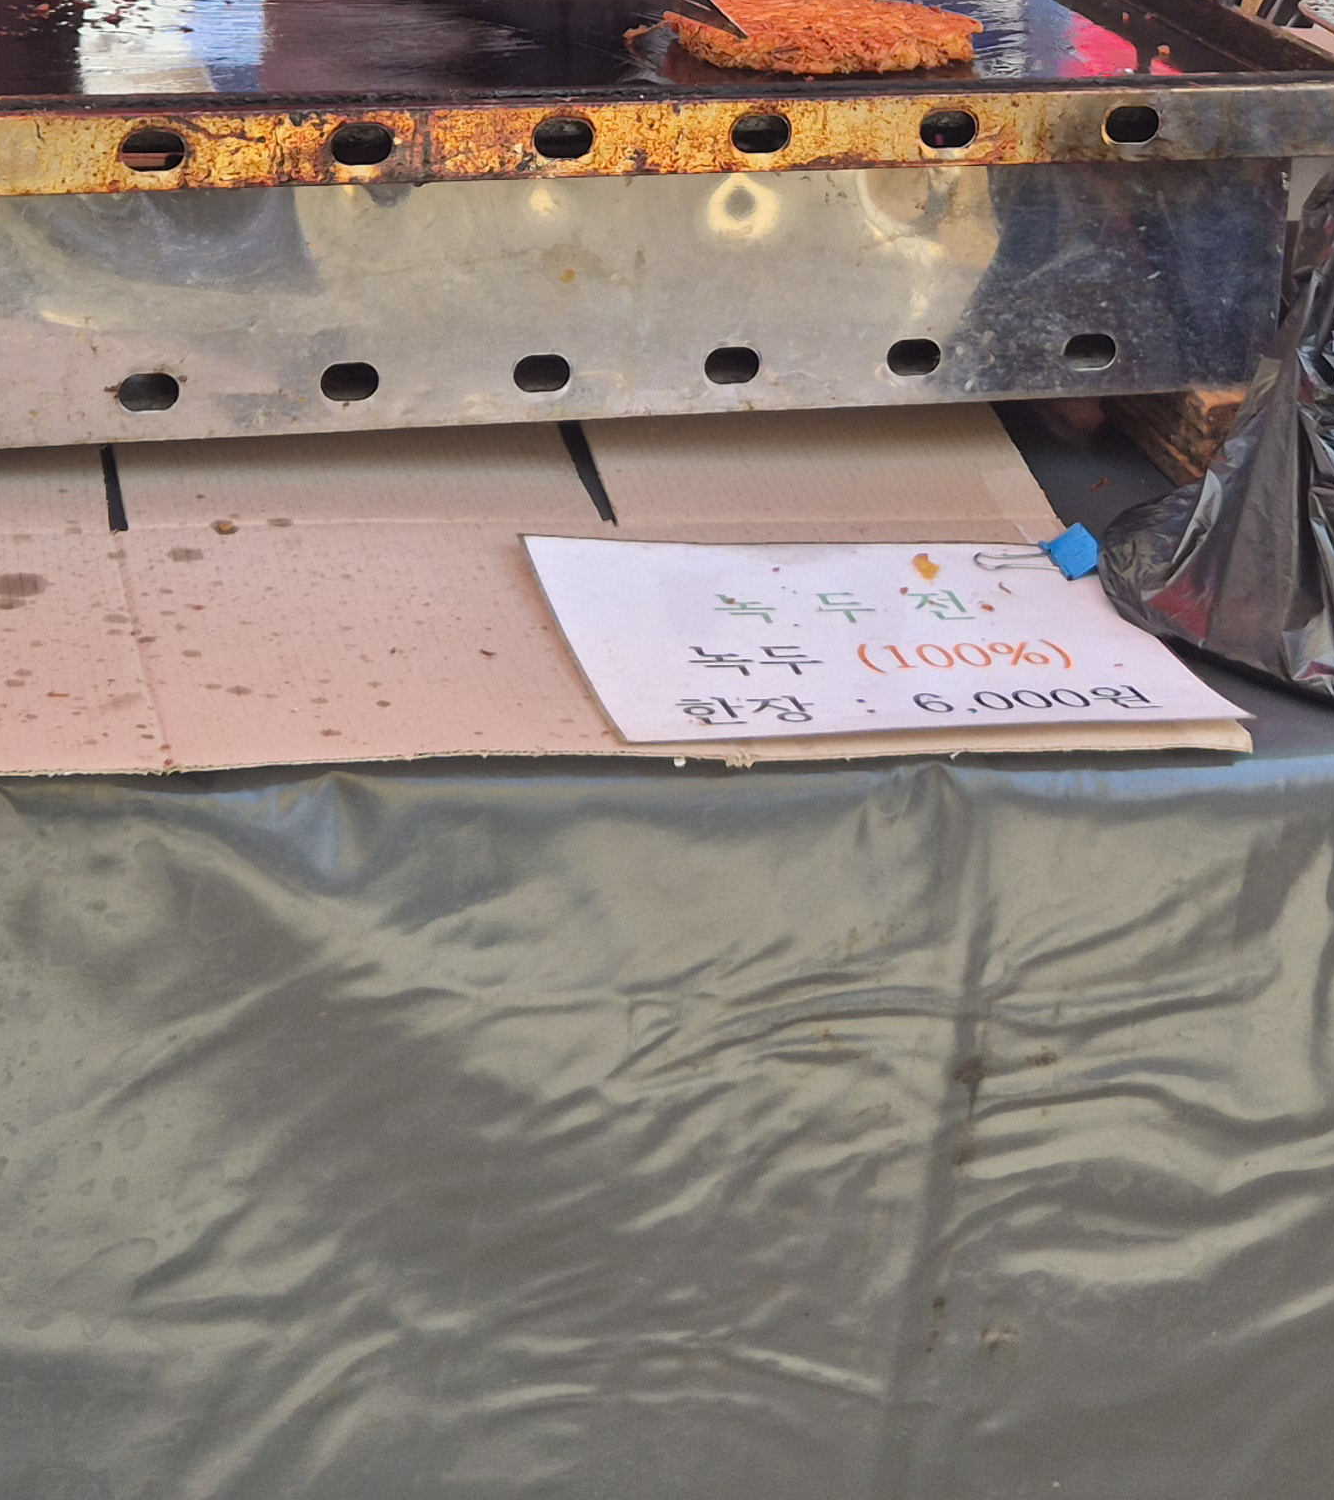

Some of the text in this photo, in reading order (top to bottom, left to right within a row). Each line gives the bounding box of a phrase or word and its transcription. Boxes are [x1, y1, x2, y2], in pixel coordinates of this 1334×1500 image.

[689, 639, 1073, 676] 녹두 (100%)
[675, 695, 815, 725] 한장
[911, 685, 1163, 714] 6,000원
